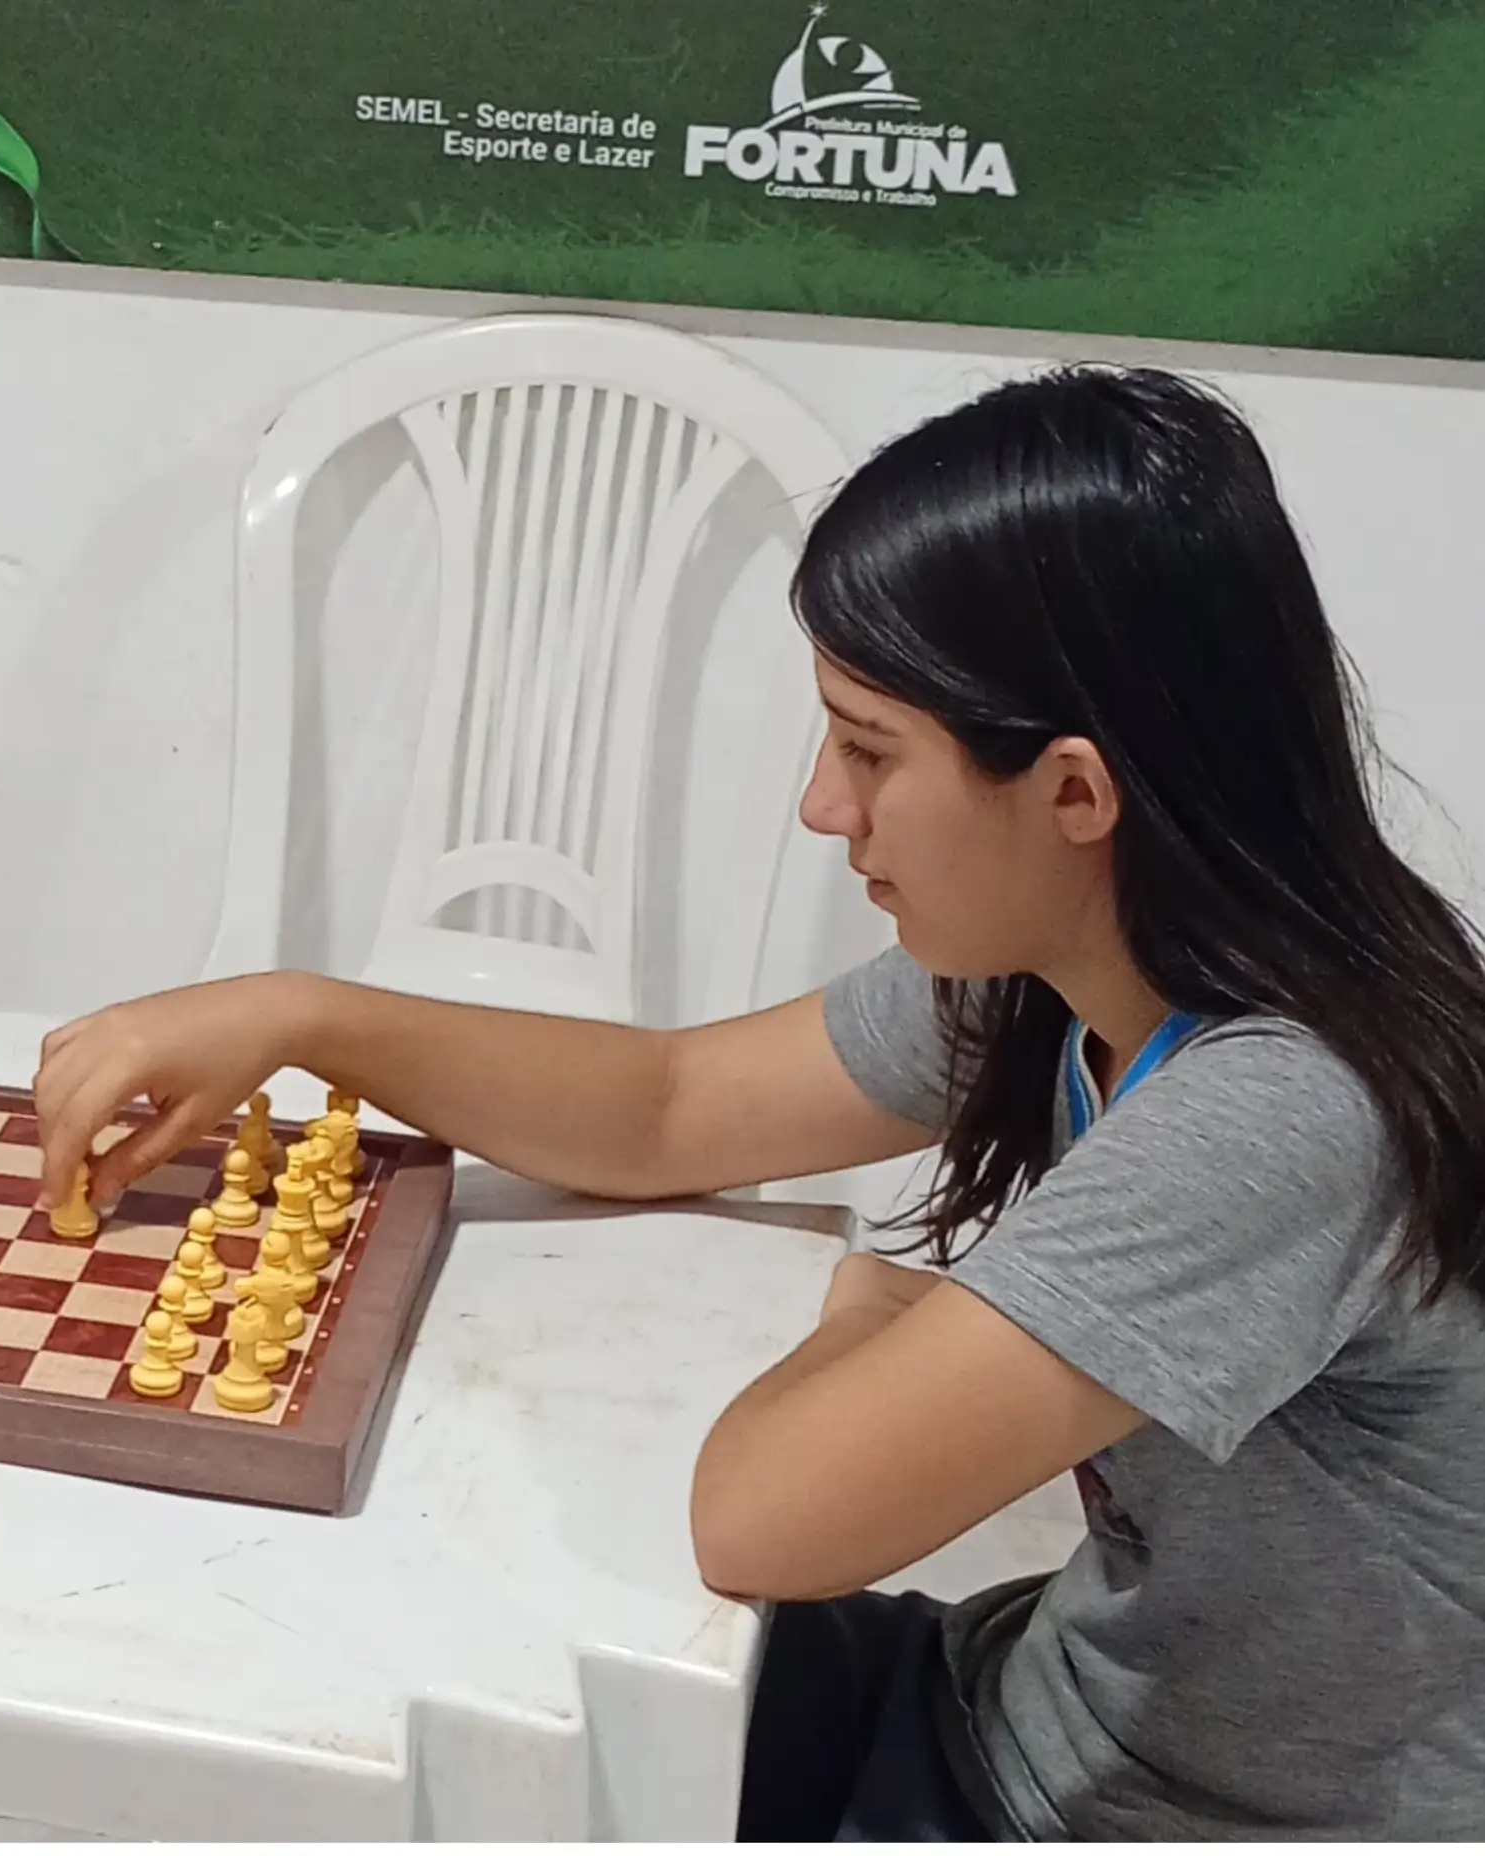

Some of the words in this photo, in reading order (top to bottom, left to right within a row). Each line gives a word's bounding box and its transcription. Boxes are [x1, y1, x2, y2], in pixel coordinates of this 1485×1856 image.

[356, 95, 449, 125] SEMEL
[476, 103, 614, 136] Secretaria
[621, 113, 656, 139] de
[804, 116, 872, 133] Prefeitura
[876, 120, 943, 138] Municipal
[947, 124, 967, 138] de
[443, 130, 547, 162] Esporte
[553, 141, 571, 162] e
[578, 139, 655, 168] Lazer
[684, 125, 1017, 196] FORTUNA
[765, 182, 859, 202] Compromisso
[862, 191, 871, 202] e
[875, 190, 937, 206] Trabalho
